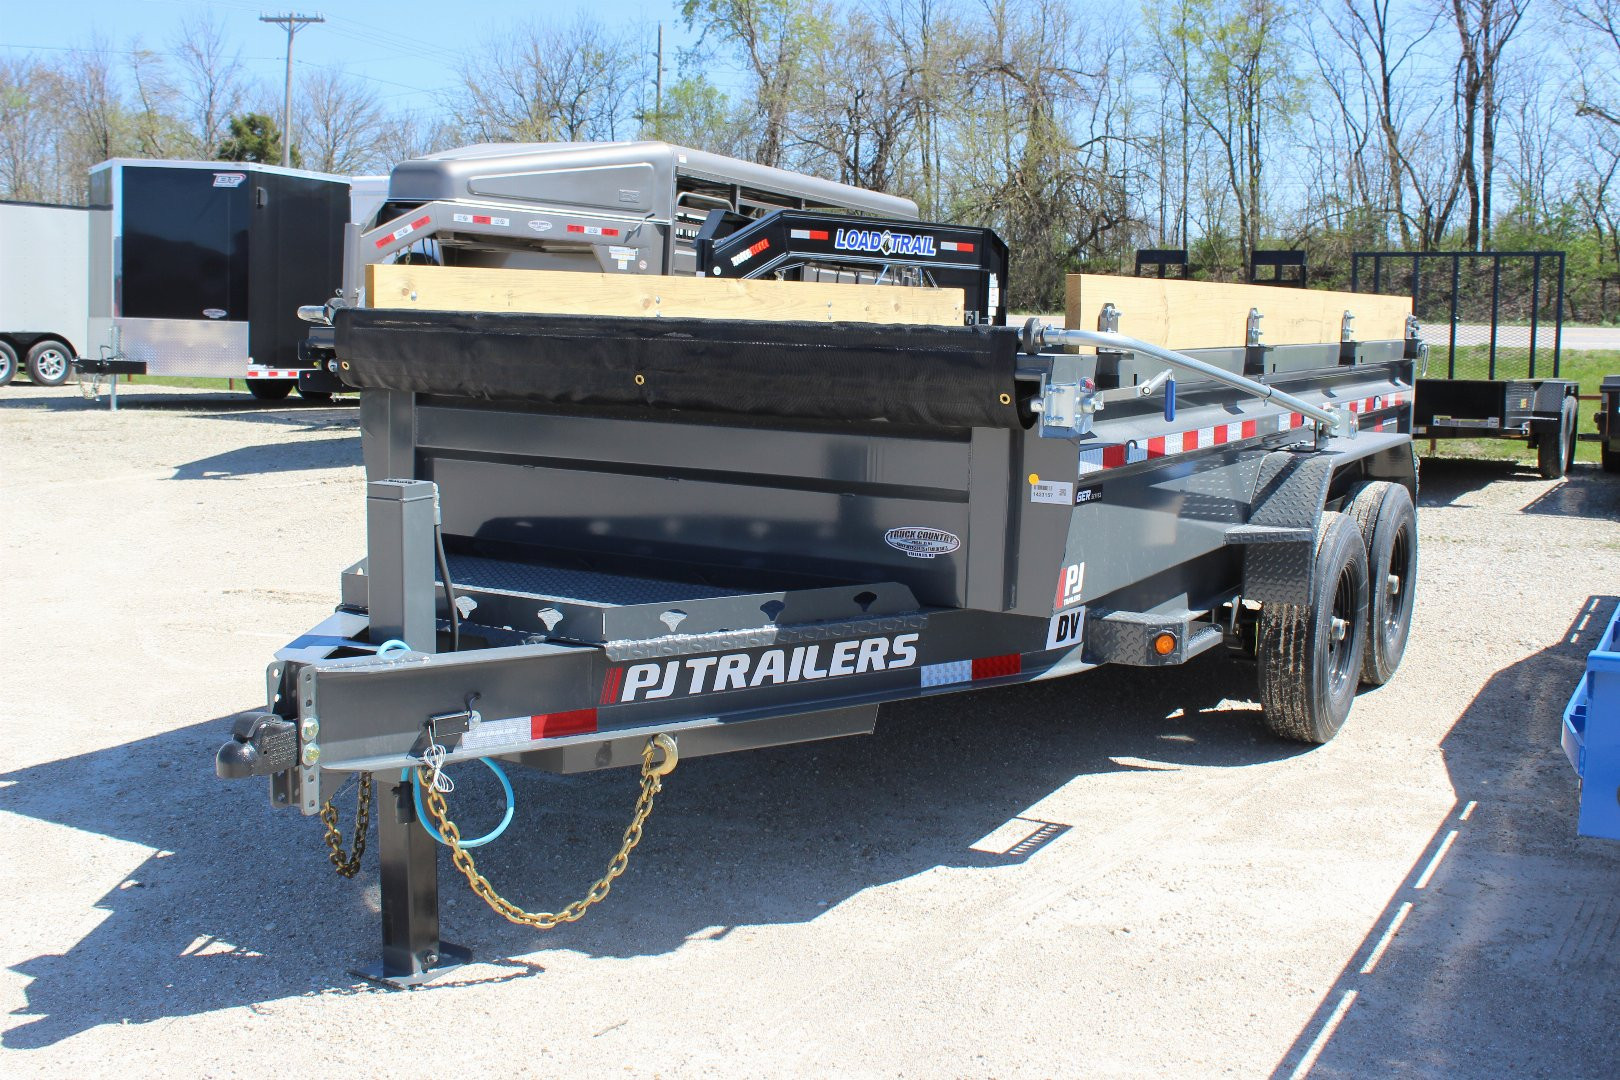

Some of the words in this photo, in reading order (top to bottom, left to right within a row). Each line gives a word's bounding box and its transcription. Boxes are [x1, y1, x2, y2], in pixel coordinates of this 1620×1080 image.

[835, 229, 881, 251] LOAD
[890, 233, 937, 257] TRAIL
[889, 530, 916, 540] TRUCK
[917, 530, 957, 544] COUNTRY
[1064, 561, 1085, 598] PJ
[1056, 611, 1081, 643] DV
[621, 660, 680, 703] PJ
[686, 633, 920, 695] TRAILERS
